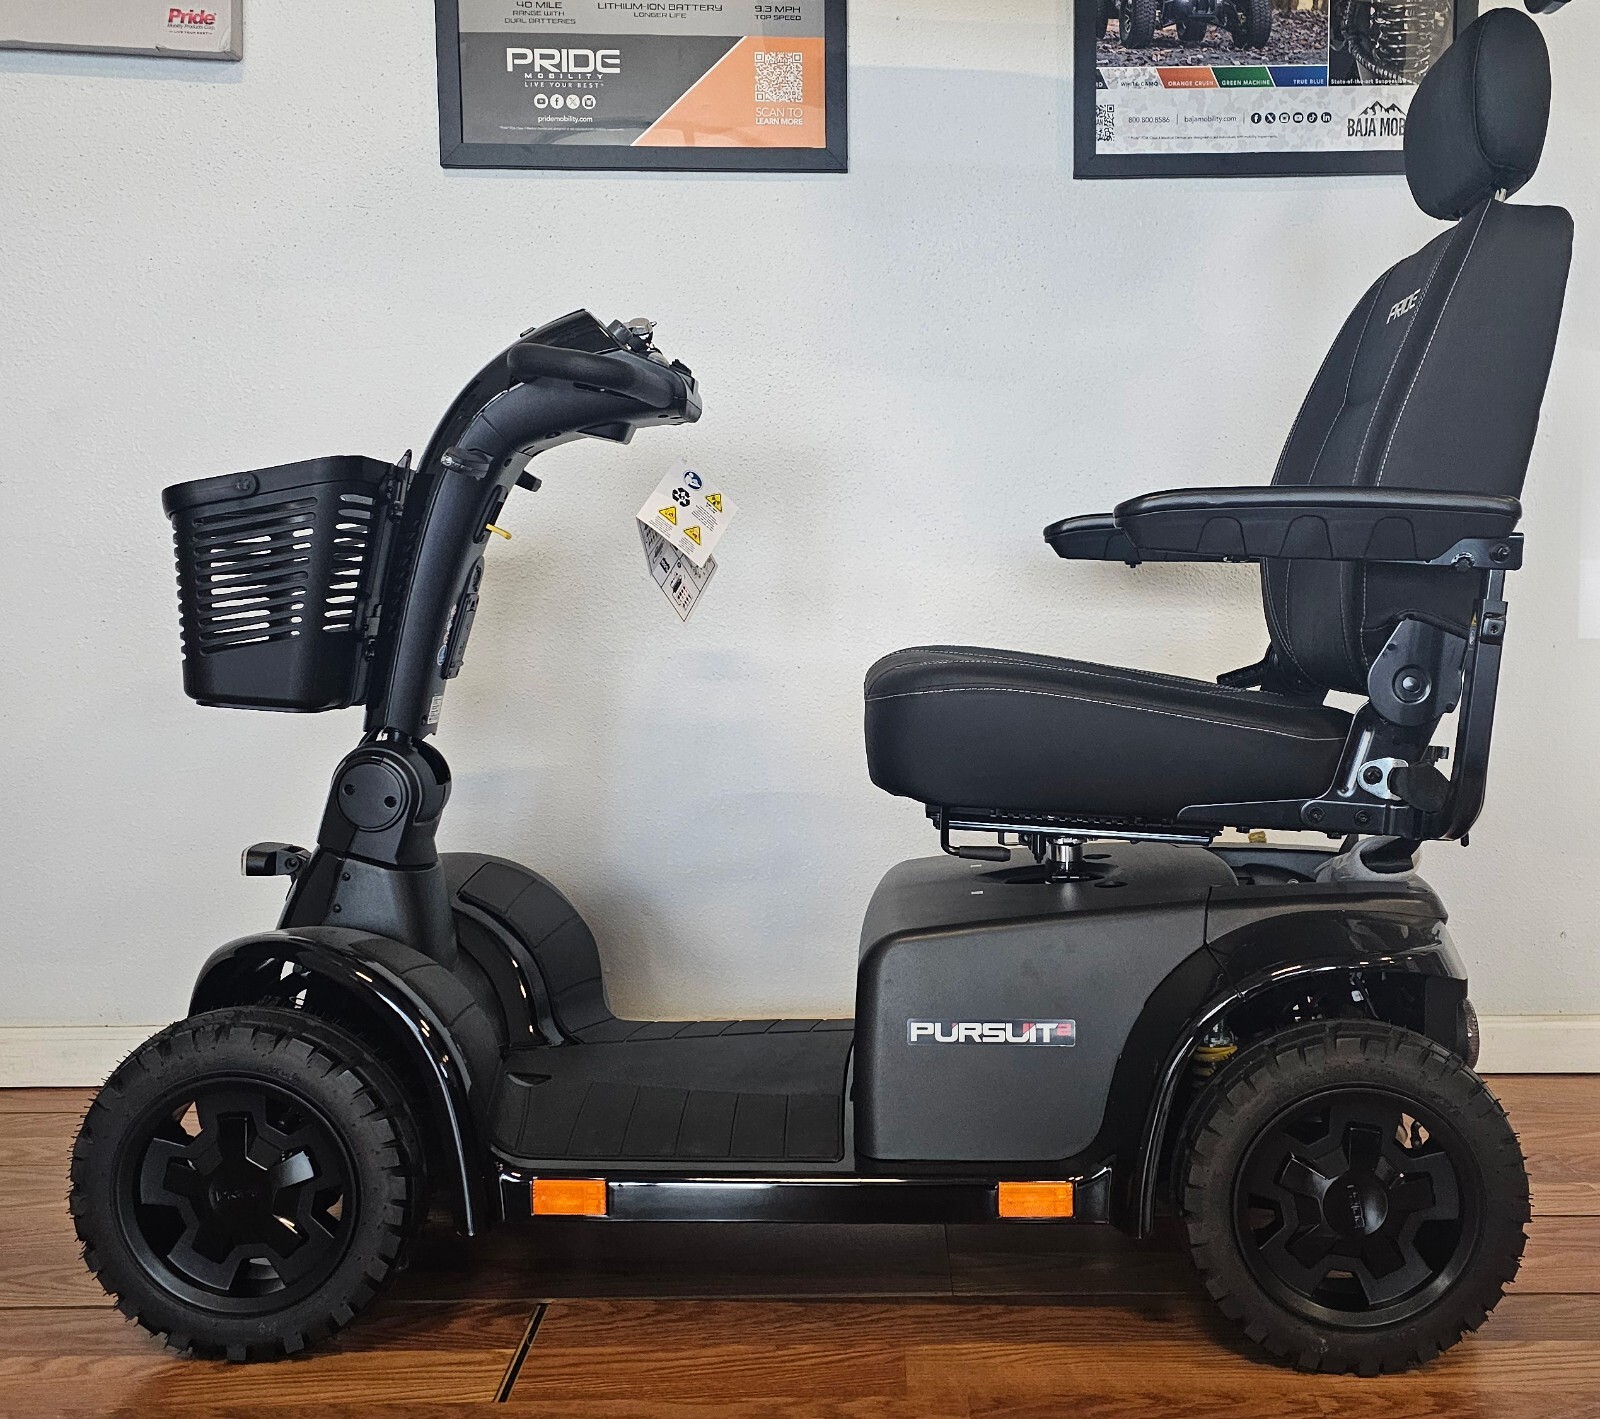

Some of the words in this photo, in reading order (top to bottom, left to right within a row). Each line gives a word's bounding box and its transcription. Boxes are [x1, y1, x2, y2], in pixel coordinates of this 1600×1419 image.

[516, 0, 532, 8] 40
[535, 1, 562, 9] MILE
[597, 2, 666, 11] LITHIUM-ION
[668, 3, 723, 12] BATTERY
[754, 5, 772, 13] 9.3
[774, 5, 801, 13] MPH
[167, 8, 216, 25] Pride
[506, 47, 621, 74] PRIDE
[524, 72, 604, 80] MOBILITY
[549, 81, 573, 89] YOUR
[755, 106, 785, 118] SCAN
[786, 107, 803, 118] TO
[537, 115, 593, 123] pridemobility.com
[755, 117, 780, 125] LEARN
[1184, 115, 1237, 124] bajamobility.com
[1347, 118, 1377, 137] BAJA
[1386, 288, 1421, 325] PRIDE
